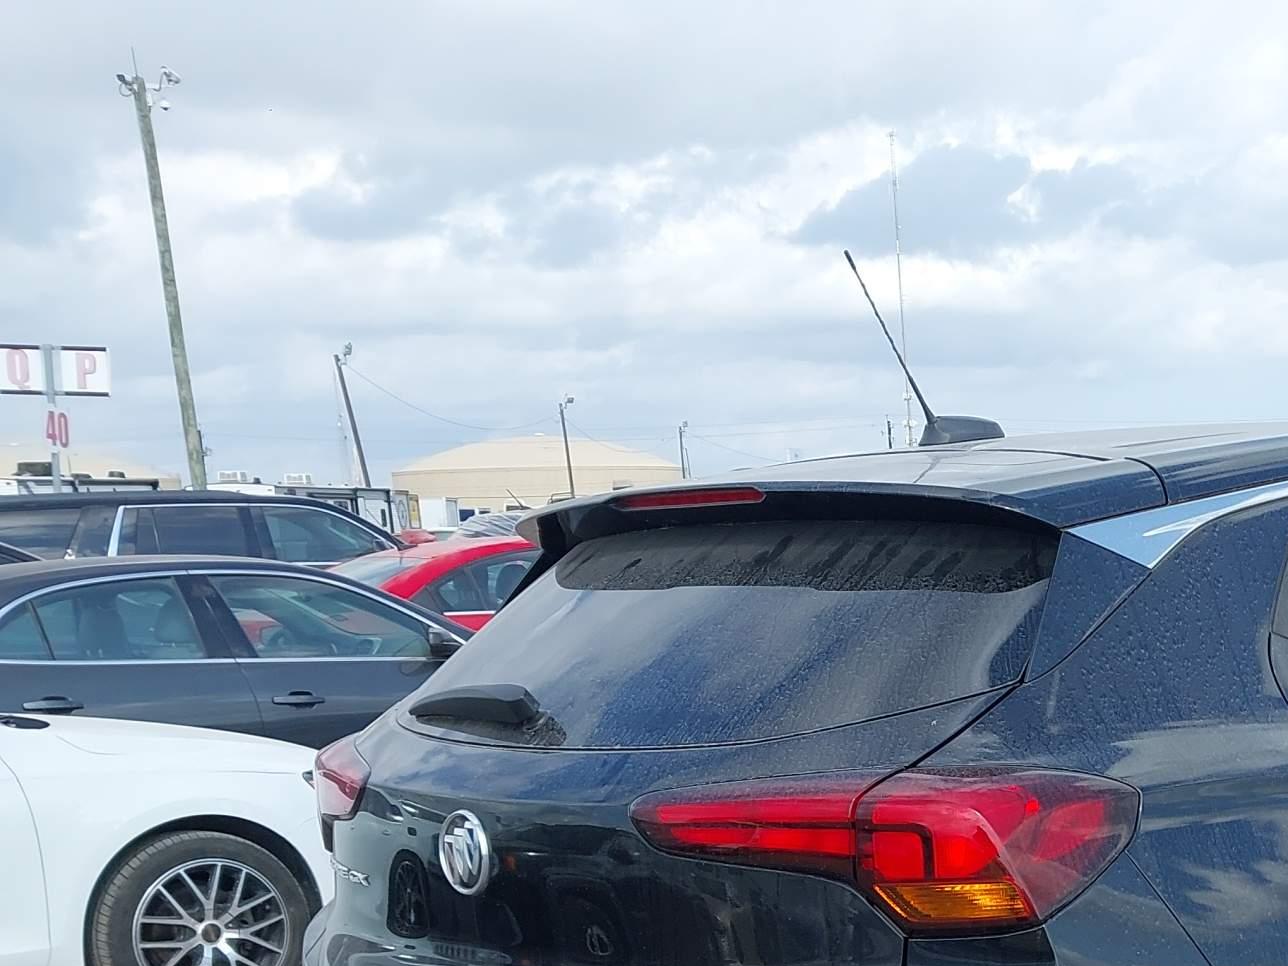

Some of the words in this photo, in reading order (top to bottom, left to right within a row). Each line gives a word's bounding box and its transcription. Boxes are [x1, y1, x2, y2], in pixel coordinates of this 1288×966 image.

[6, 348, 31, 390] Q
[75, 352, 97, 390] P
[46, 410, 70, 449] 40
